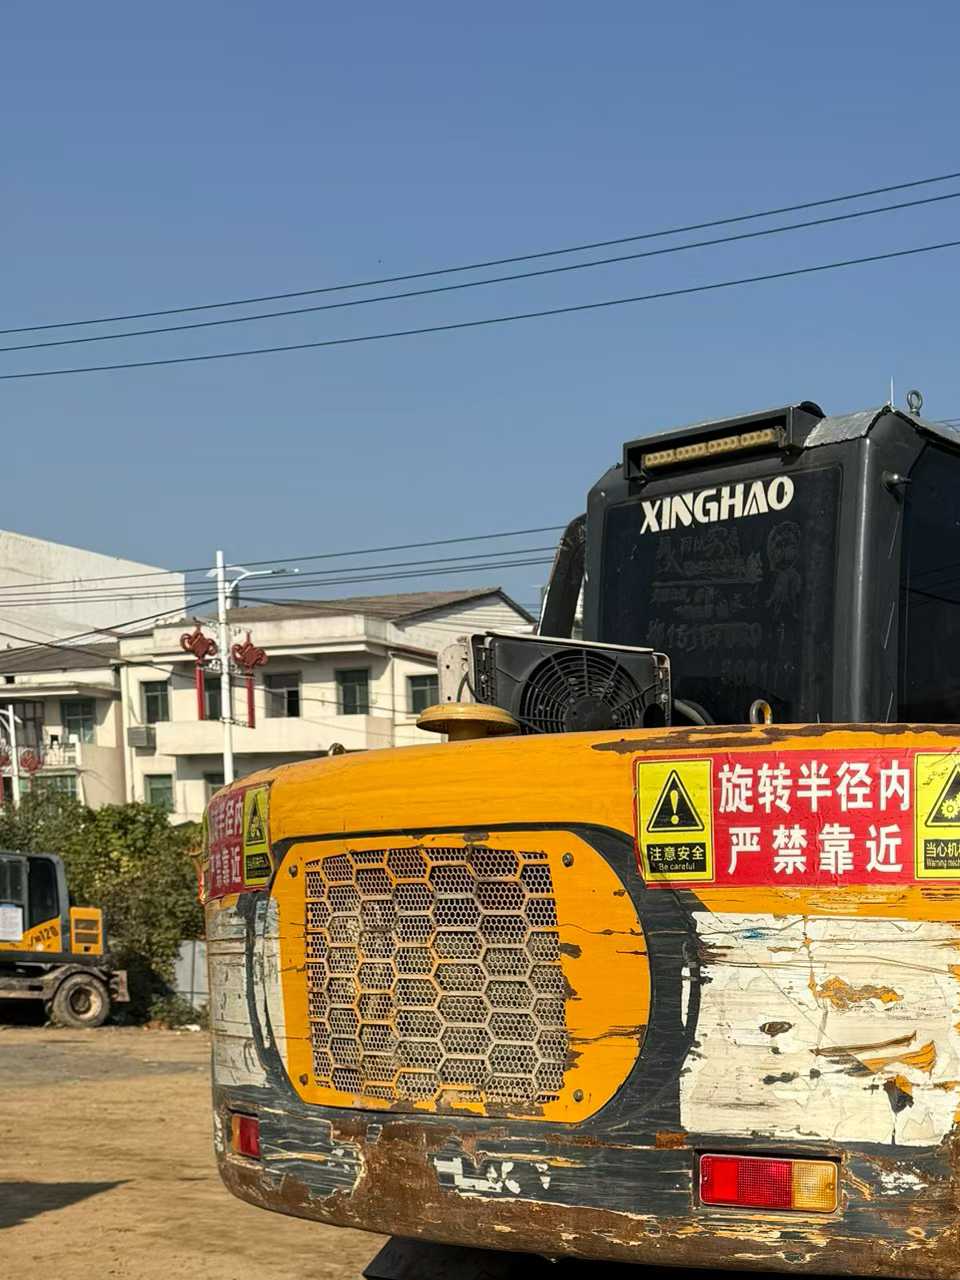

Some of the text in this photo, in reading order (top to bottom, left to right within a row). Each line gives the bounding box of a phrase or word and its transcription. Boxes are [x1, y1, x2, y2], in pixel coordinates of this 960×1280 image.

[640, 475, 795, 535] XINGHAO
[718, 760, 910, 814] 旋转半径内
[650, 845, 704, 861] 注意安全
[670, 862, 695, 870] careful
[728, 823, 903, 876] 严禁靠近
